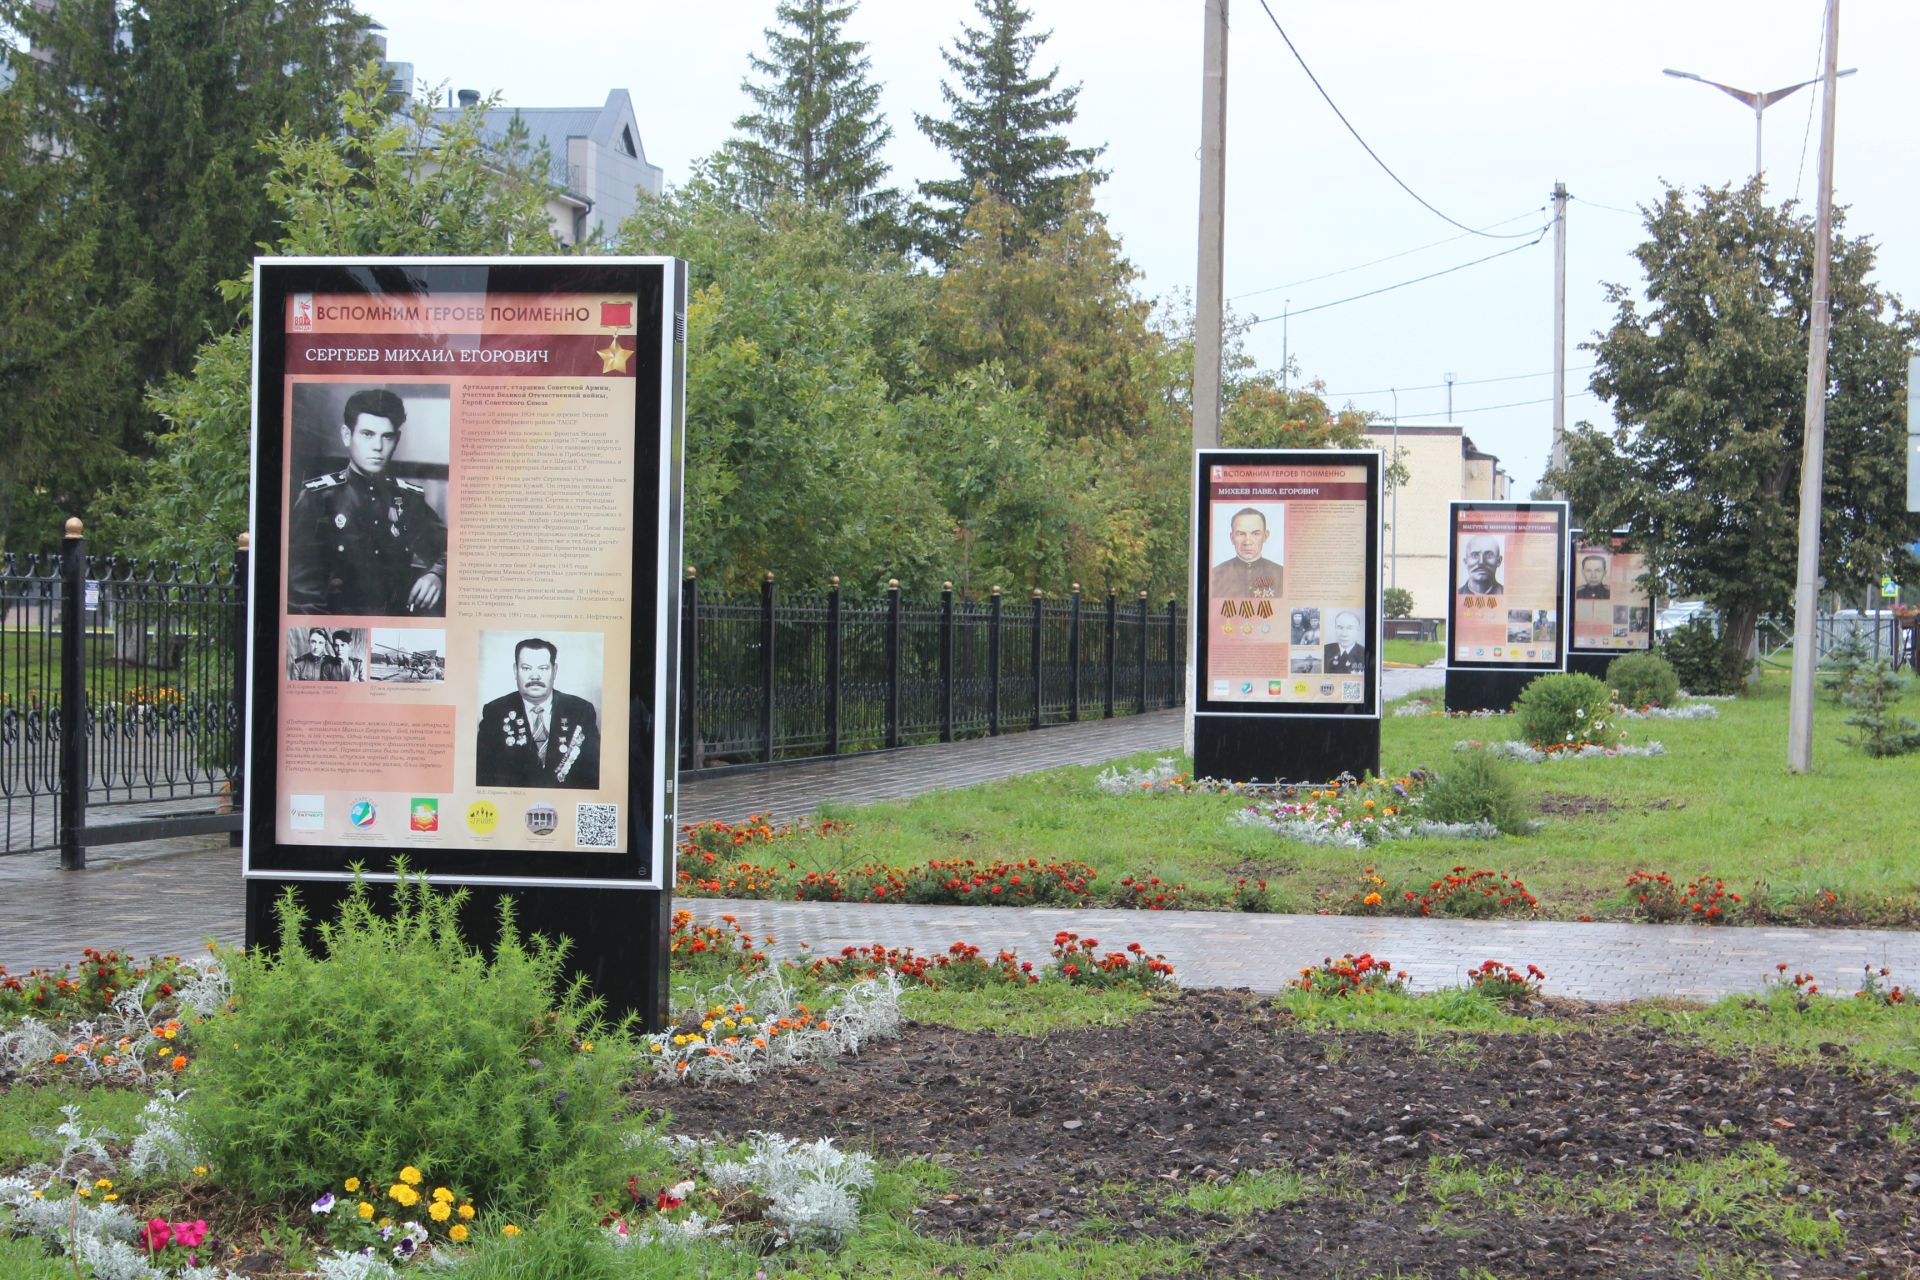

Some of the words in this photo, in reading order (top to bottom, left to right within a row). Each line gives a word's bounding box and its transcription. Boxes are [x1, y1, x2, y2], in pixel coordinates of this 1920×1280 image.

[317, 306, 420, 321] ВСПОМНИМ
[425, 306, 485, 321] ГЕРОЕВ
[491, 307, 590, 322] ПОИМЕННО
[305, 348, 380, 362] СЕРГЕЕВ
[384, 348, 455, 362] МИХАИЛ
[460, 350, 549, 363] ЕГОРОВИЧ
[1223, 470, 1270, 478] ВСПОМНИМ
[1271, 470, 1299, 478] ГЕРОЕВ
[1300, 470, 1346, 478] ПОИМЕННО
